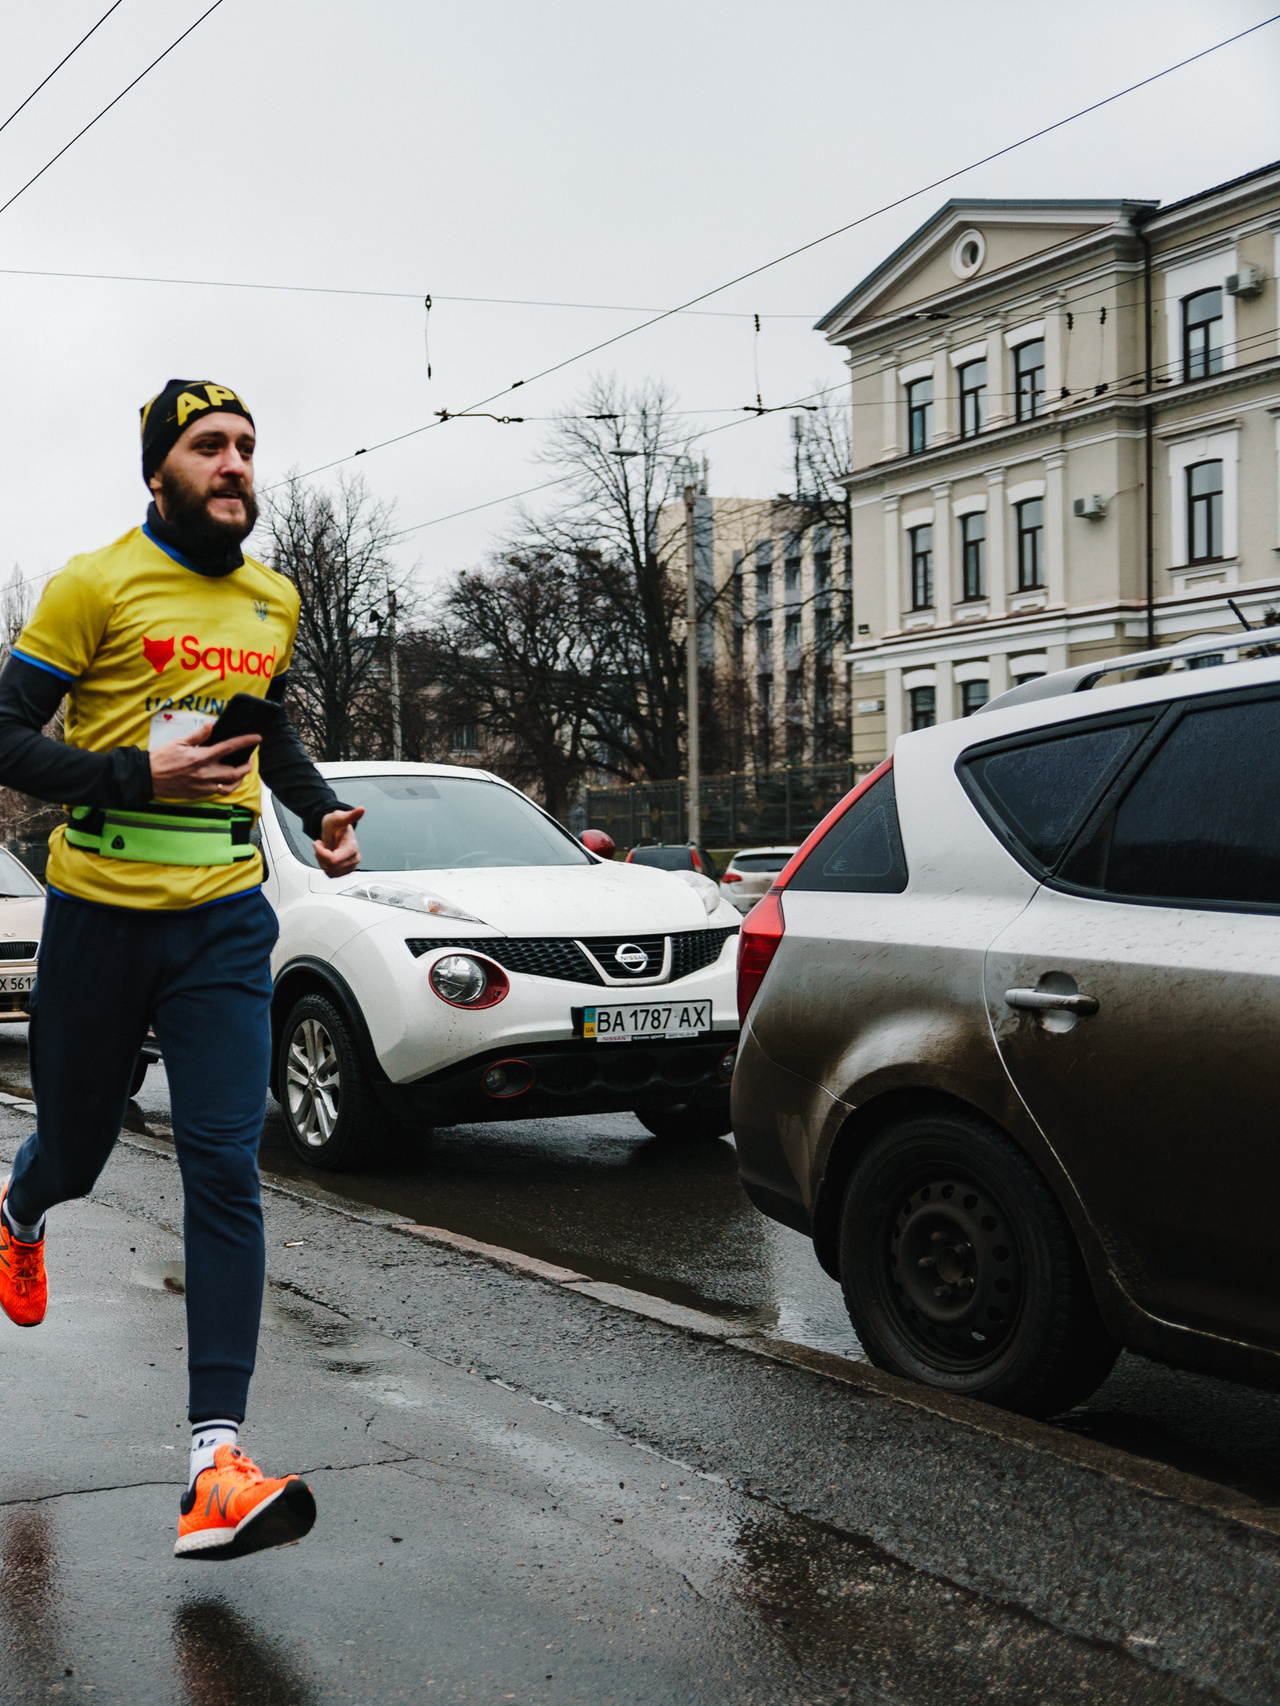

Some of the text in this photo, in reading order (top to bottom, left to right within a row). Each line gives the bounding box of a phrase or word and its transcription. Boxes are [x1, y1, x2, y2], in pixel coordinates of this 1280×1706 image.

[177, 385, 249, 426] AP
[180, 635, 276, 681] Squad
[597, 1005, 707, 1033] BA 1787 AX
